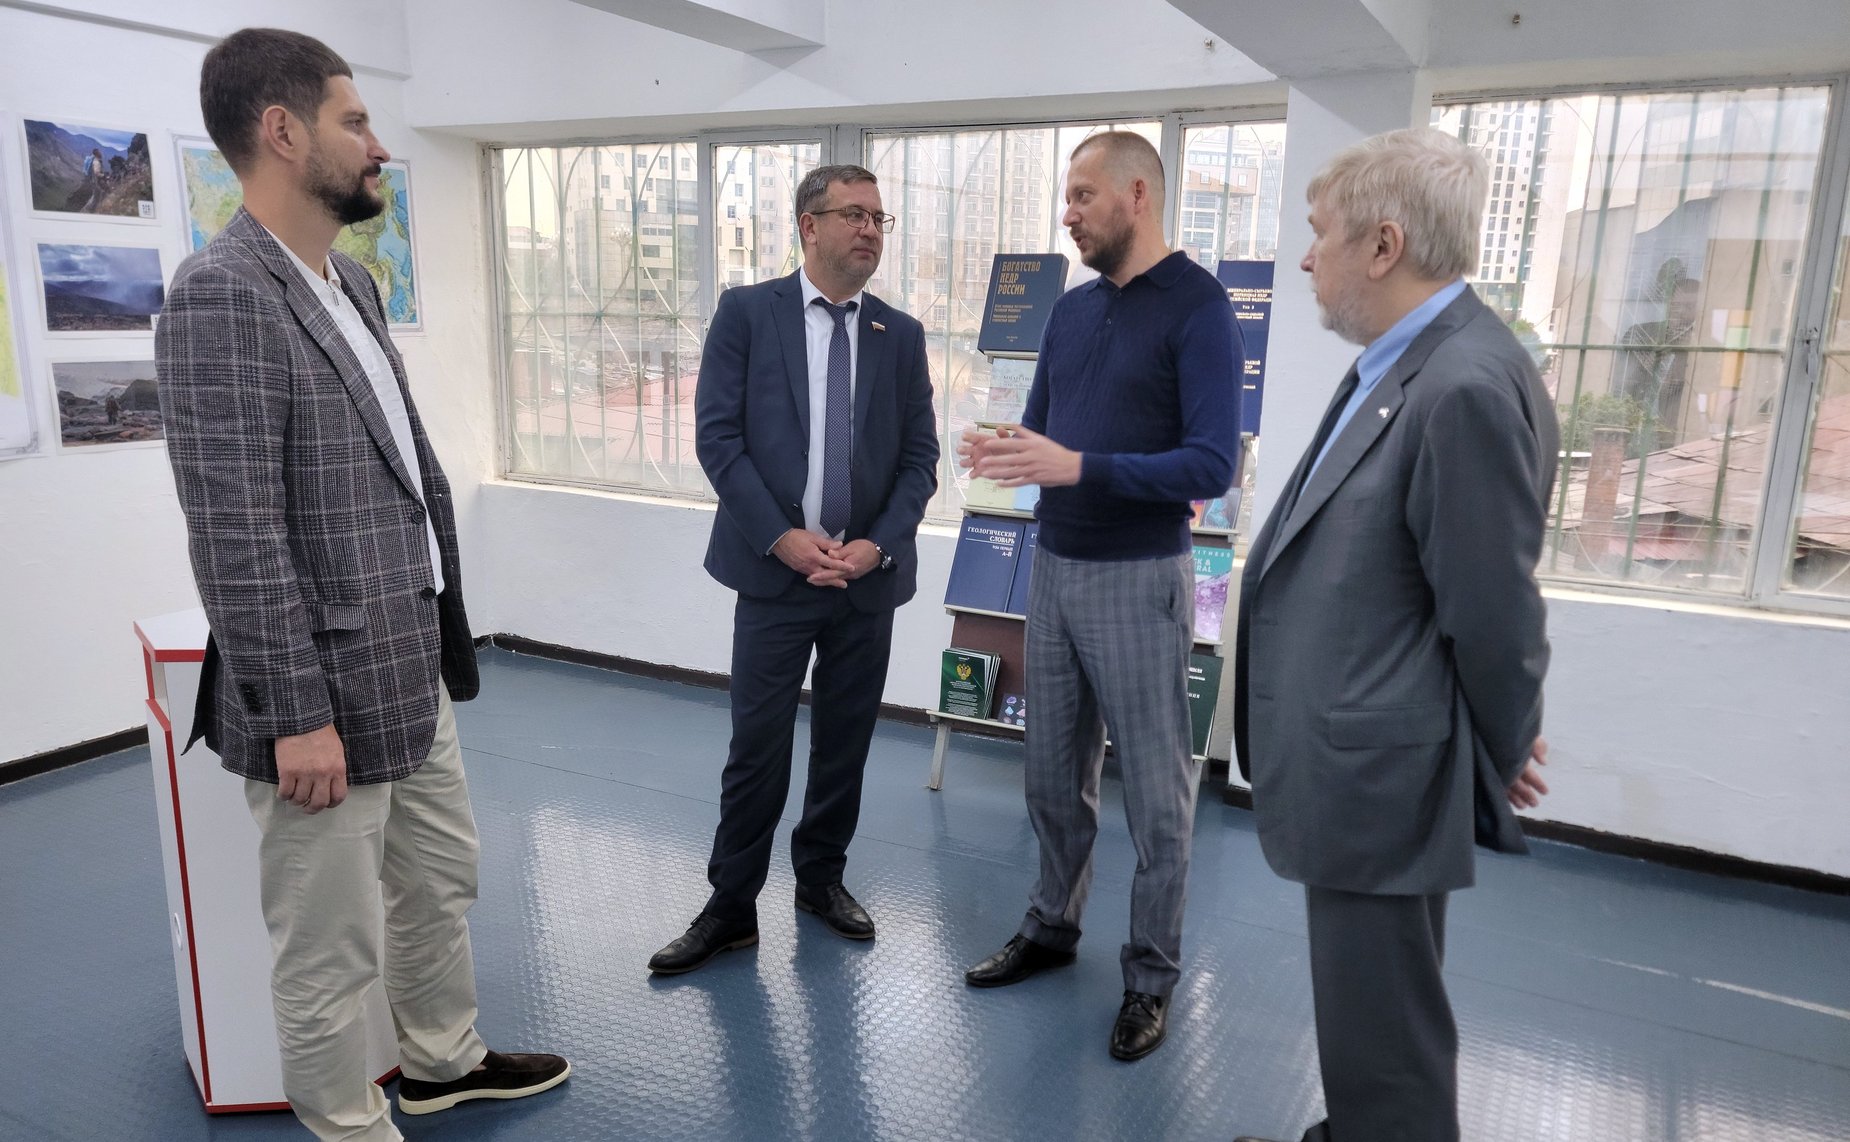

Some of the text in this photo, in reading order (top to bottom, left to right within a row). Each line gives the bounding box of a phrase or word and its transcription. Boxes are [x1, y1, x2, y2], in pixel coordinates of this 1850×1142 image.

[1002, 261, 1040, 272] БОГАТСТВО
[1000, 273, 1019, 283] НЕДР
[997, 284, 1025, 295] РОССИИ
[967, 526, 1017, 538] ГЕОЛОГИЧЕСКИЙ
[989, 535, 1015, 544] СЛОВАРЬ
